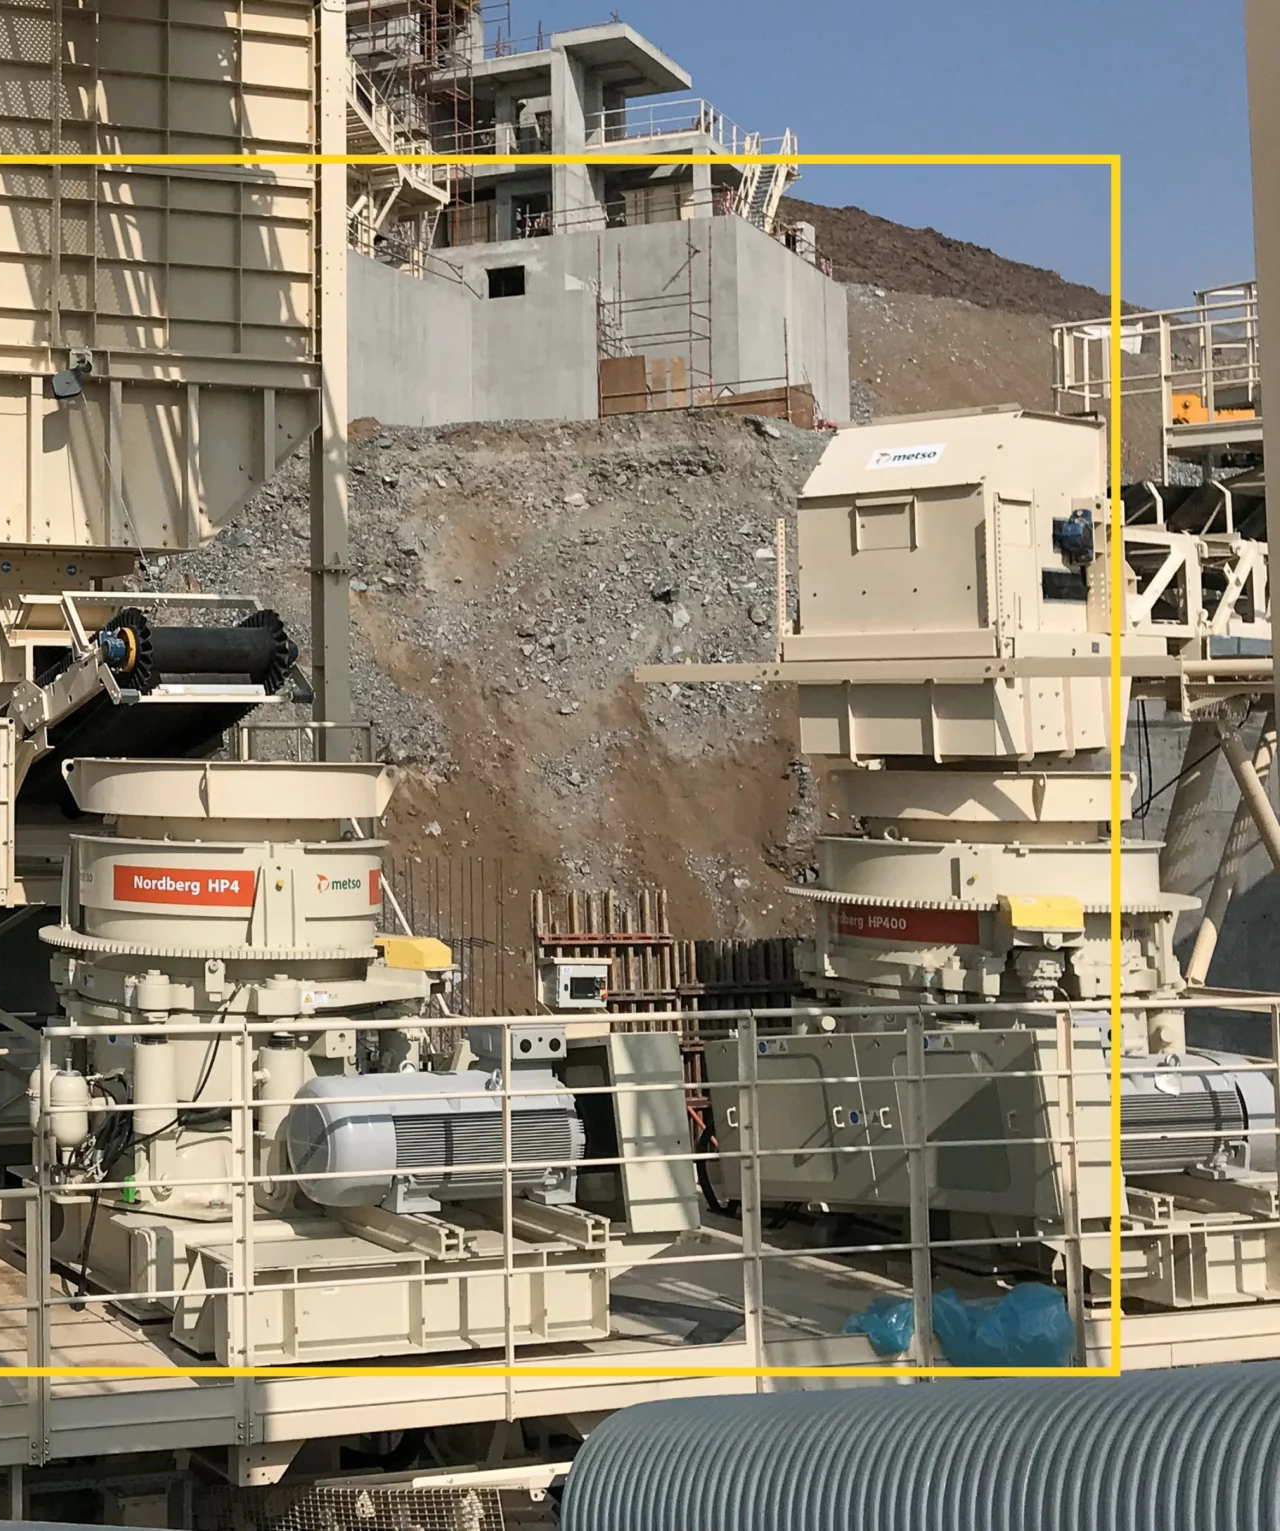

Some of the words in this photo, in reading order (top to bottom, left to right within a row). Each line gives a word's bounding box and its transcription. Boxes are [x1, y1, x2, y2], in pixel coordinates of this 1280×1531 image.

[892, 451, 937, 462] metso
[133, 875, 200, 896] Nordberg
[208, 878, 241, 894] HP4
[331, 878, 361, 890] metso
[868, 915, 907, 930] HP400
